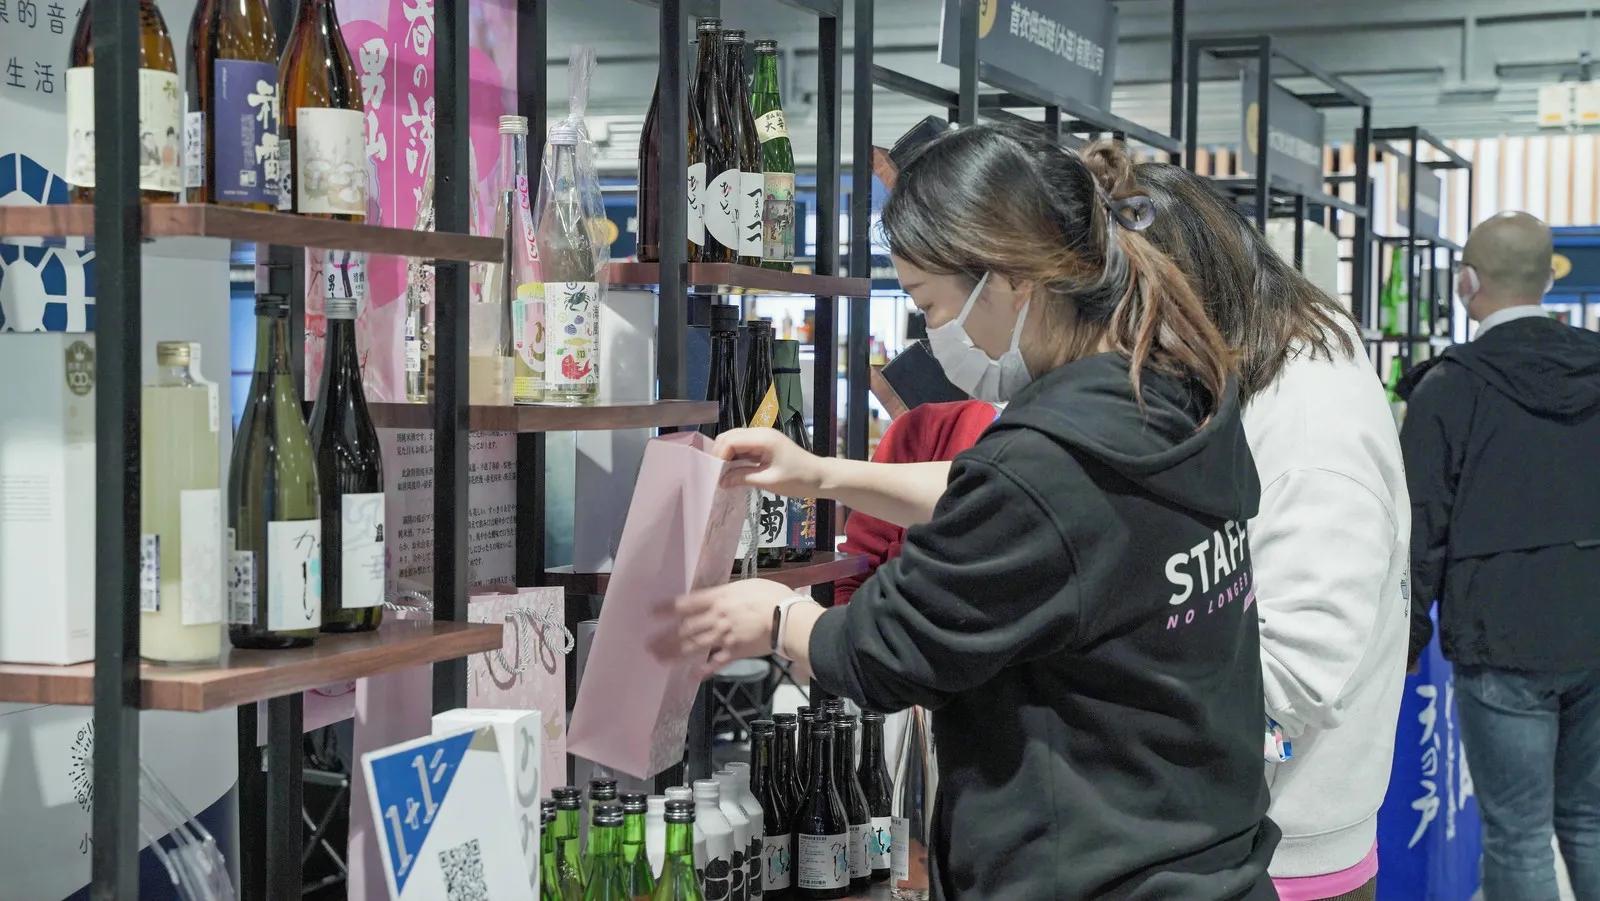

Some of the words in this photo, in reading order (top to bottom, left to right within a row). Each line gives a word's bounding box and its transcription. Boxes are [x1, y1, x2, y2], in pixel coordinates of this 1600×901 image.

[6, 57, 55, 93] 生活
[759, 493, 785, 544] 菊
[1164, 519, 1246, 606] STAFF
[1166, 608, 1196, 630] NO
